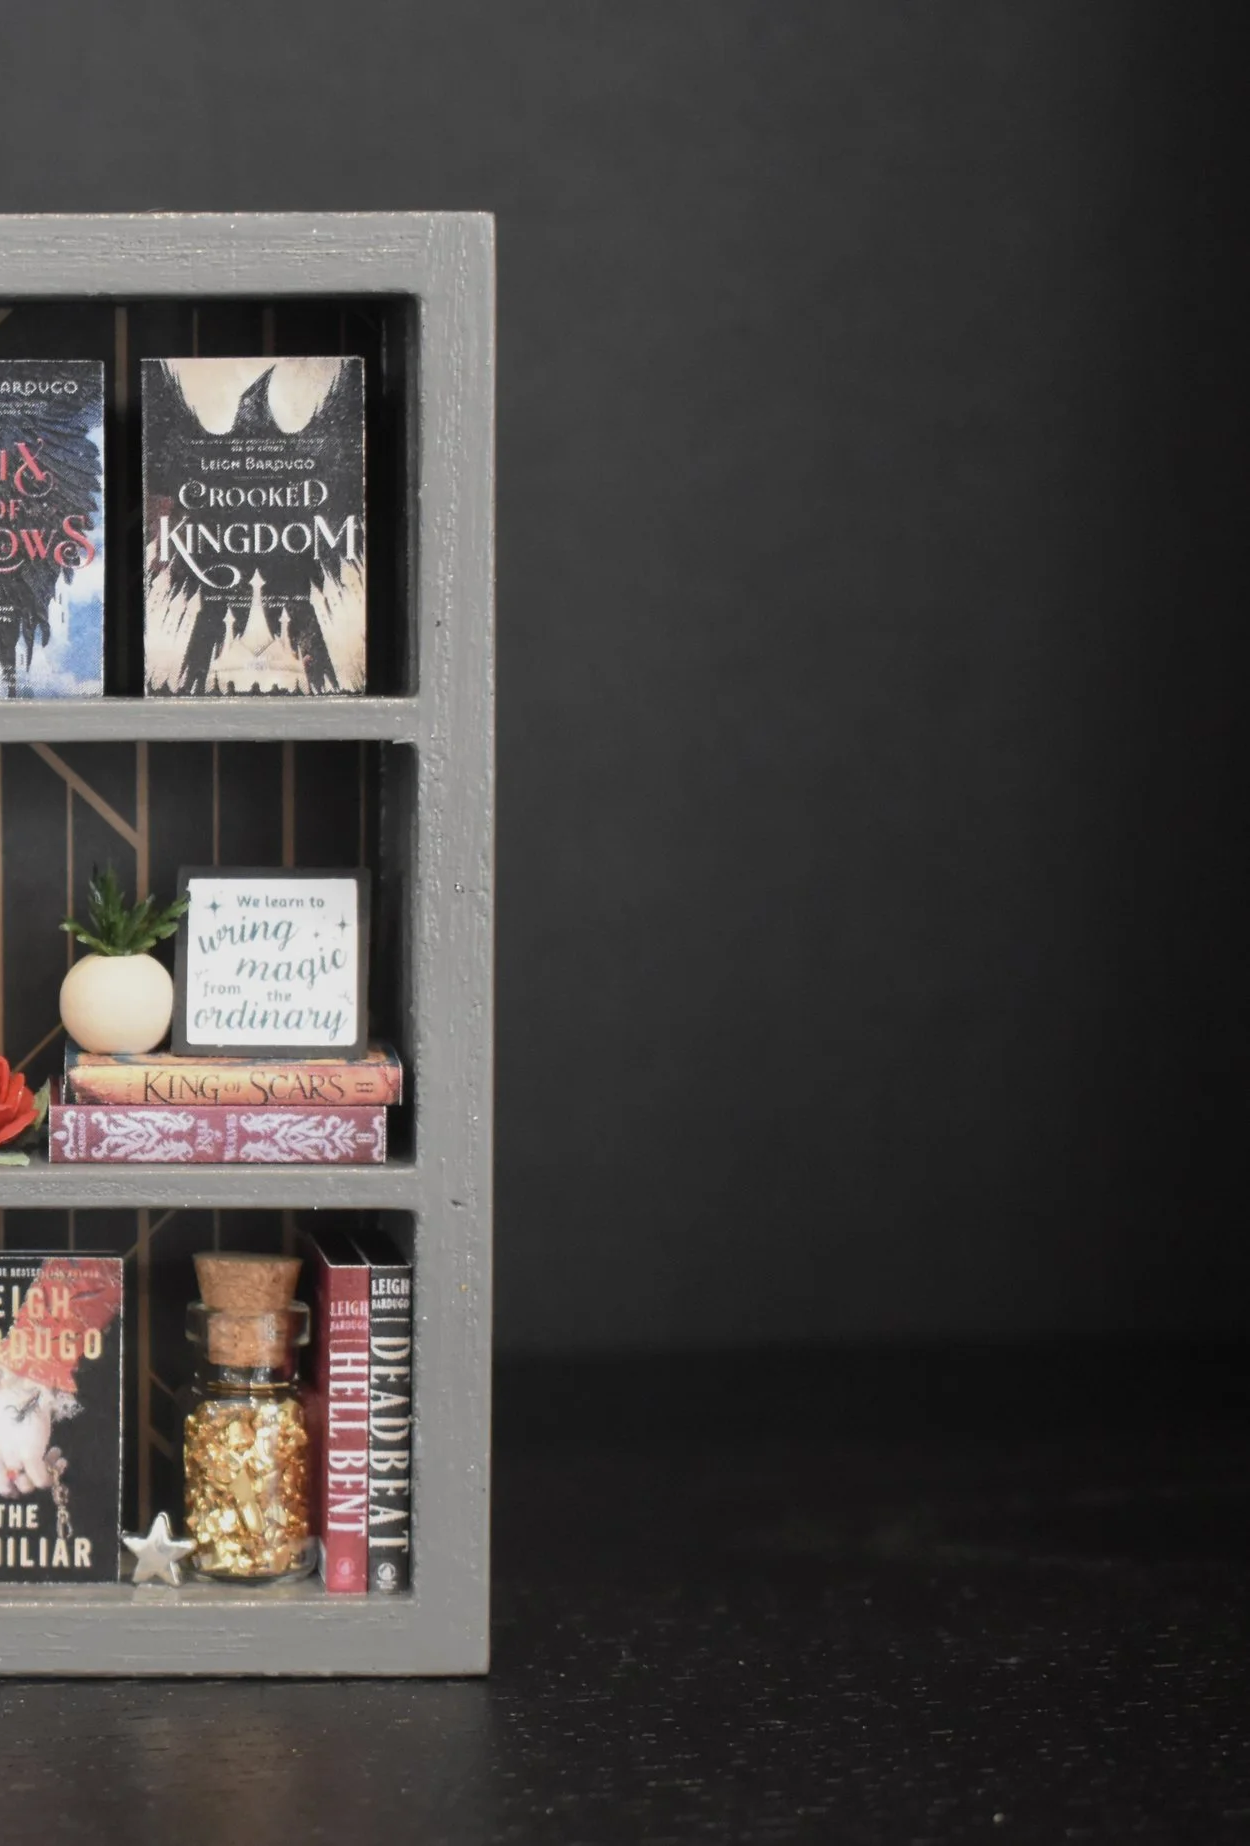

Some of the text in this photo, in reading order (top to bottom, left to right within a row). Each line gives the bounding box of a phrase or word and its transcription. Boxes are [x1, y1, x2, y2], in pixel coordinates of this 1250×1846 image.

[200, 457, 315, 472] LEIGH BARDUGO
[178, 478, 328, 511] CROOKED
[160, 514, 359, 589] KINGDOM
[236, 895, 325, 909] We learn to
[197, 915, 300, 955] wring
[235, 946, 348, 991] magic
[202, 980, 242, 998] from
[266, 989, 293, 1003] the
[194, 999, 349, 1042] ordinary
[143, 1070, 220, 1105] KING
[249, 1070, 346, 1106] SCARS
[371, 1277, 410, 1296] LEIGH
[329, 1300, 369, 1317] LEIGH
[370, 1297, 410, 1311] BARDUGO
[328, 1351, 369, 1438] HELL
[327, 1450, 369, 1537] BENT
